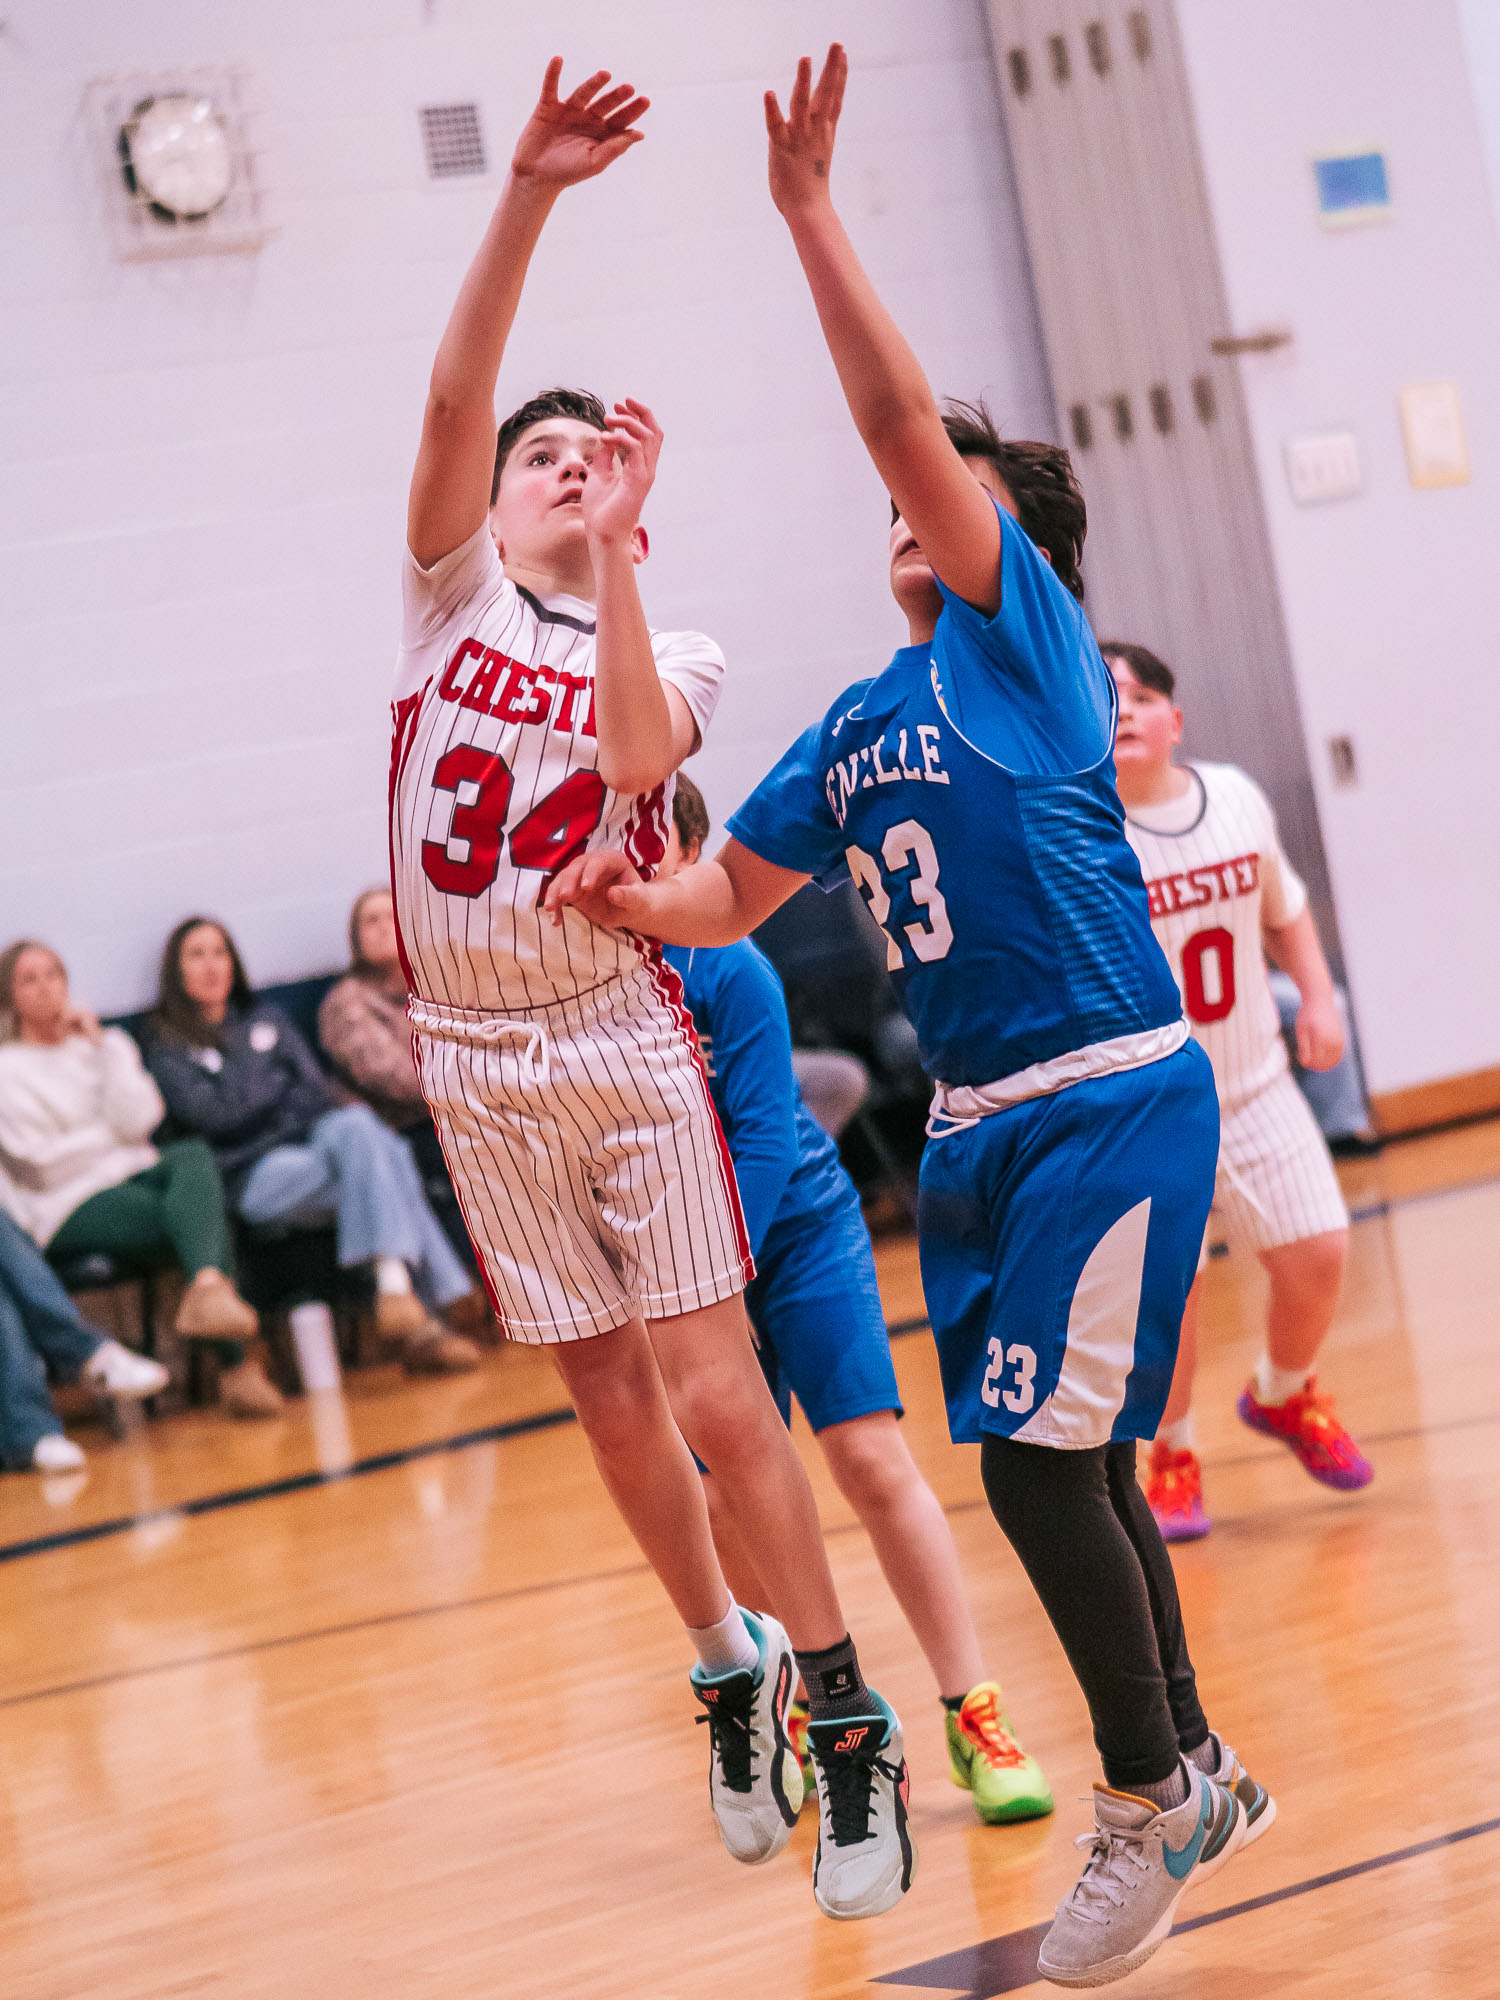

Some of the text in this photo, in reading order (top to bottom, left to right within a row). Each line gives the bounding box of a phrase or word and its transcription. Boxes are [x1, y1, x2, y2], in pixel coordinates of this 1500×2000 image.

[421, 742, 608, 905] 34
[1181, 927, 1236, 1025] 0
[981, 1336, 1037, 1415] 23
